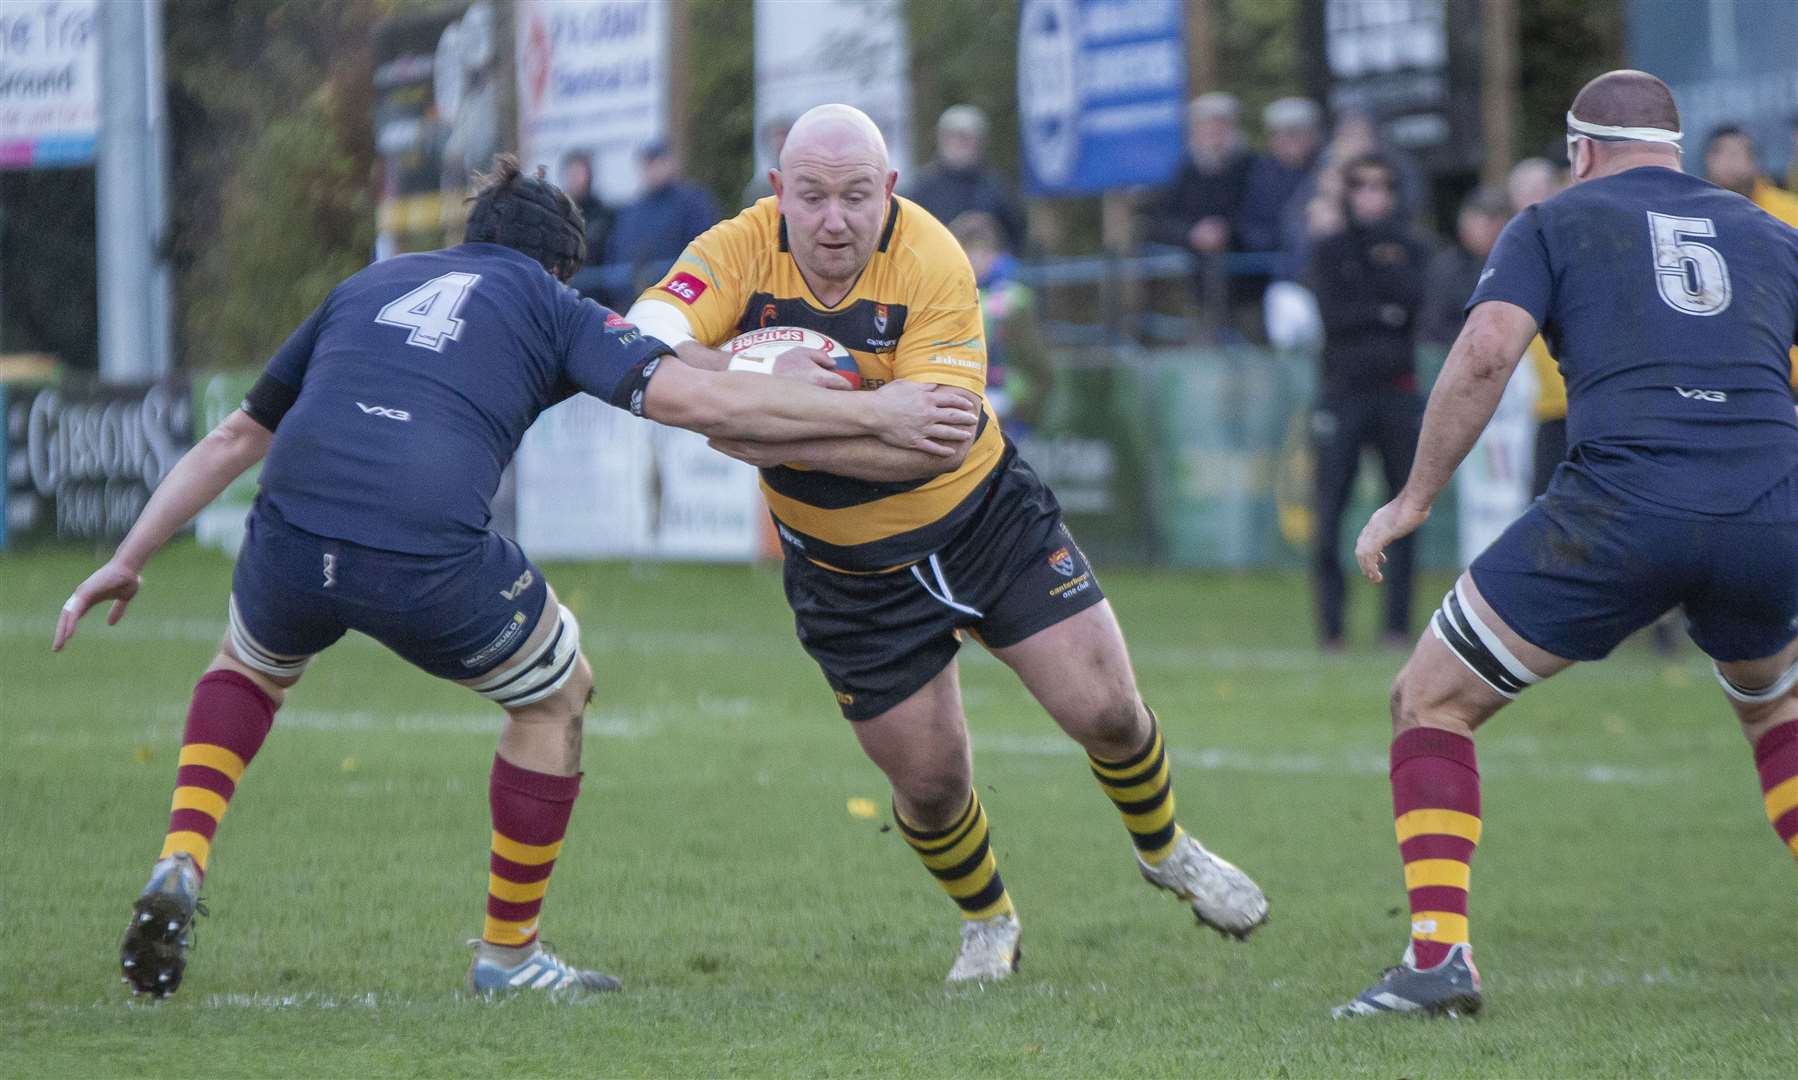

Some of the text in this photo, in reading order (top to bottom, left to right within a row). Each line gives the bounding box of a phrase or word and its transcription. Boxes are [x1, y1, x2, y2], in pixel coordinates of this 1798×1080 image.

[1646, 210, 1732, 316] 5
[667, 279, 696, 299] tfs
[374, 271, 481, 353] 4
[732, 330, 801, 352] SPITFIRE
[1673, 385, 1728, 402] VX3
[355, 402, 411, 421] VX3
